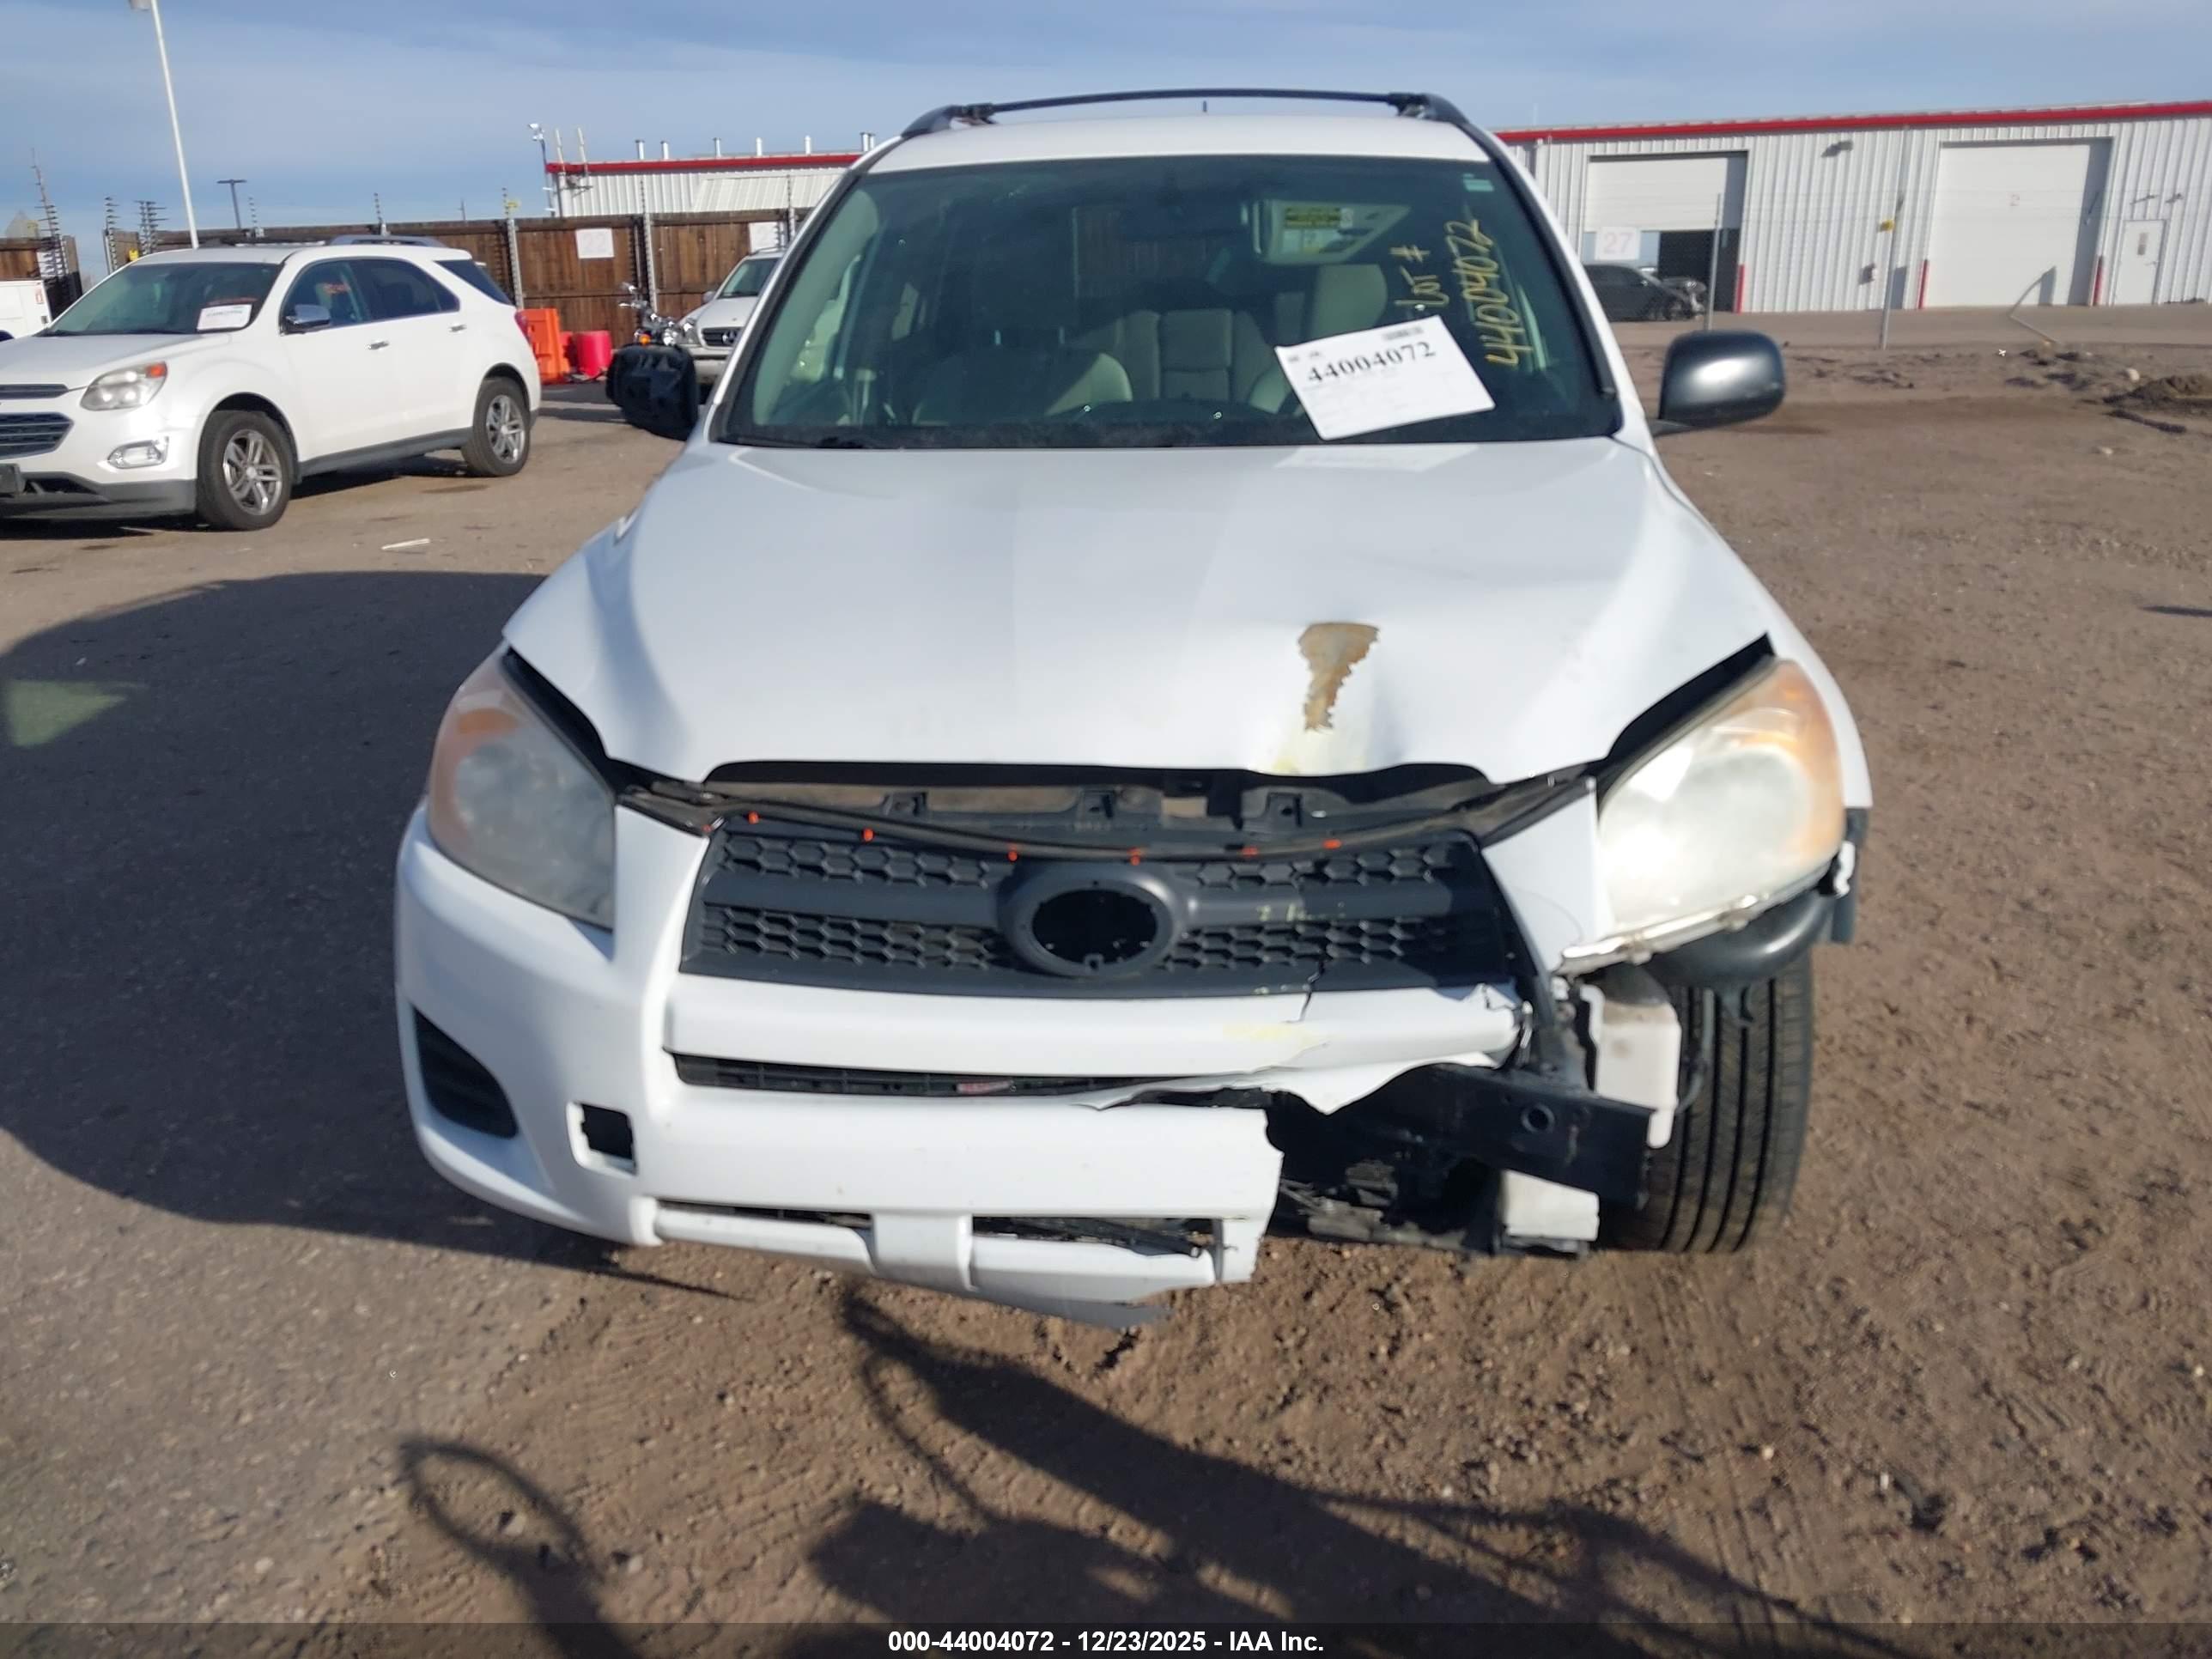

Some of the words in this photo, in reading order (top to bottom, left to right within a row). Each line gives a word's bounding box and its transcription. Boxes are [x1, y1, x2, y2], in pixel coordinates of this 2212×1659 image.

[1603, 233, 1634, 254] 27
[1443, 219, 1534, 367] 44004072
[1308, 342, 1436, 383] 44004072
